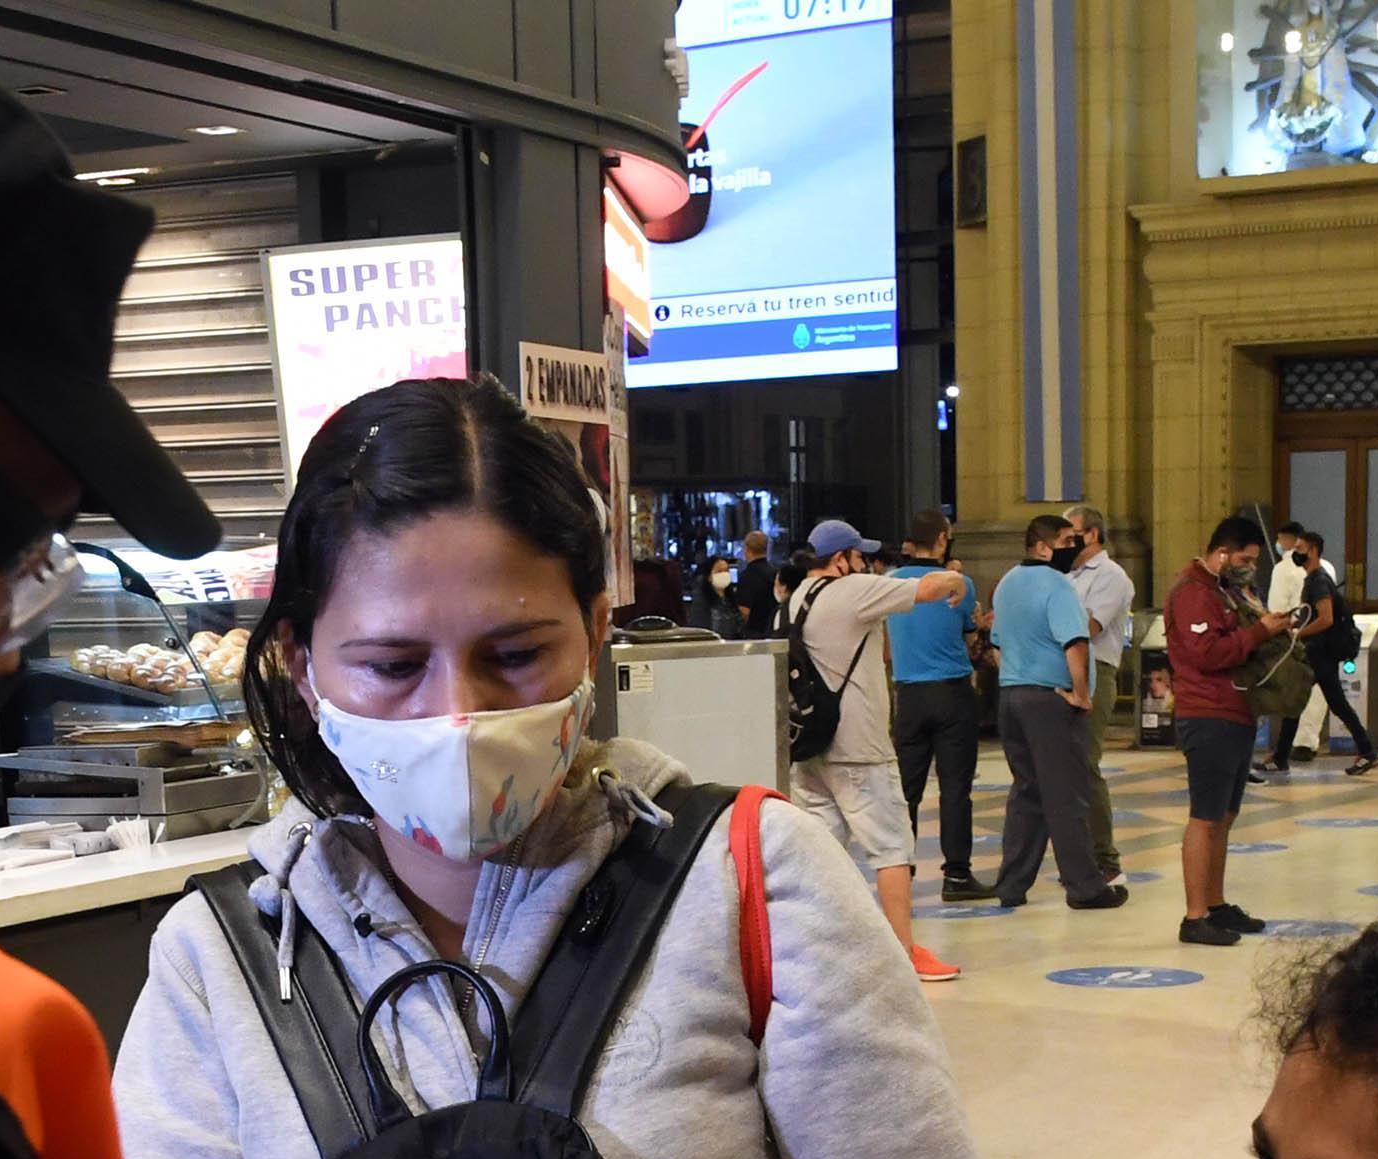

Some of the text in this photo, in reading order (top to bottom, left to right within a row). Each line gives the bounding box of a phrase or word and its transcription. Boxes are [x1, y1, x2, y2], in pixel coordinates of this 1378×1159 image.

[689, 167, 772, 193] la vajilla
[289, 259, 436, 297] SUPER
[680, 287, 894, 319] Reservá tu tren sentid
[526, 355, 534, 401] 2
[538, 357, 607, 411] EMPANADAS
